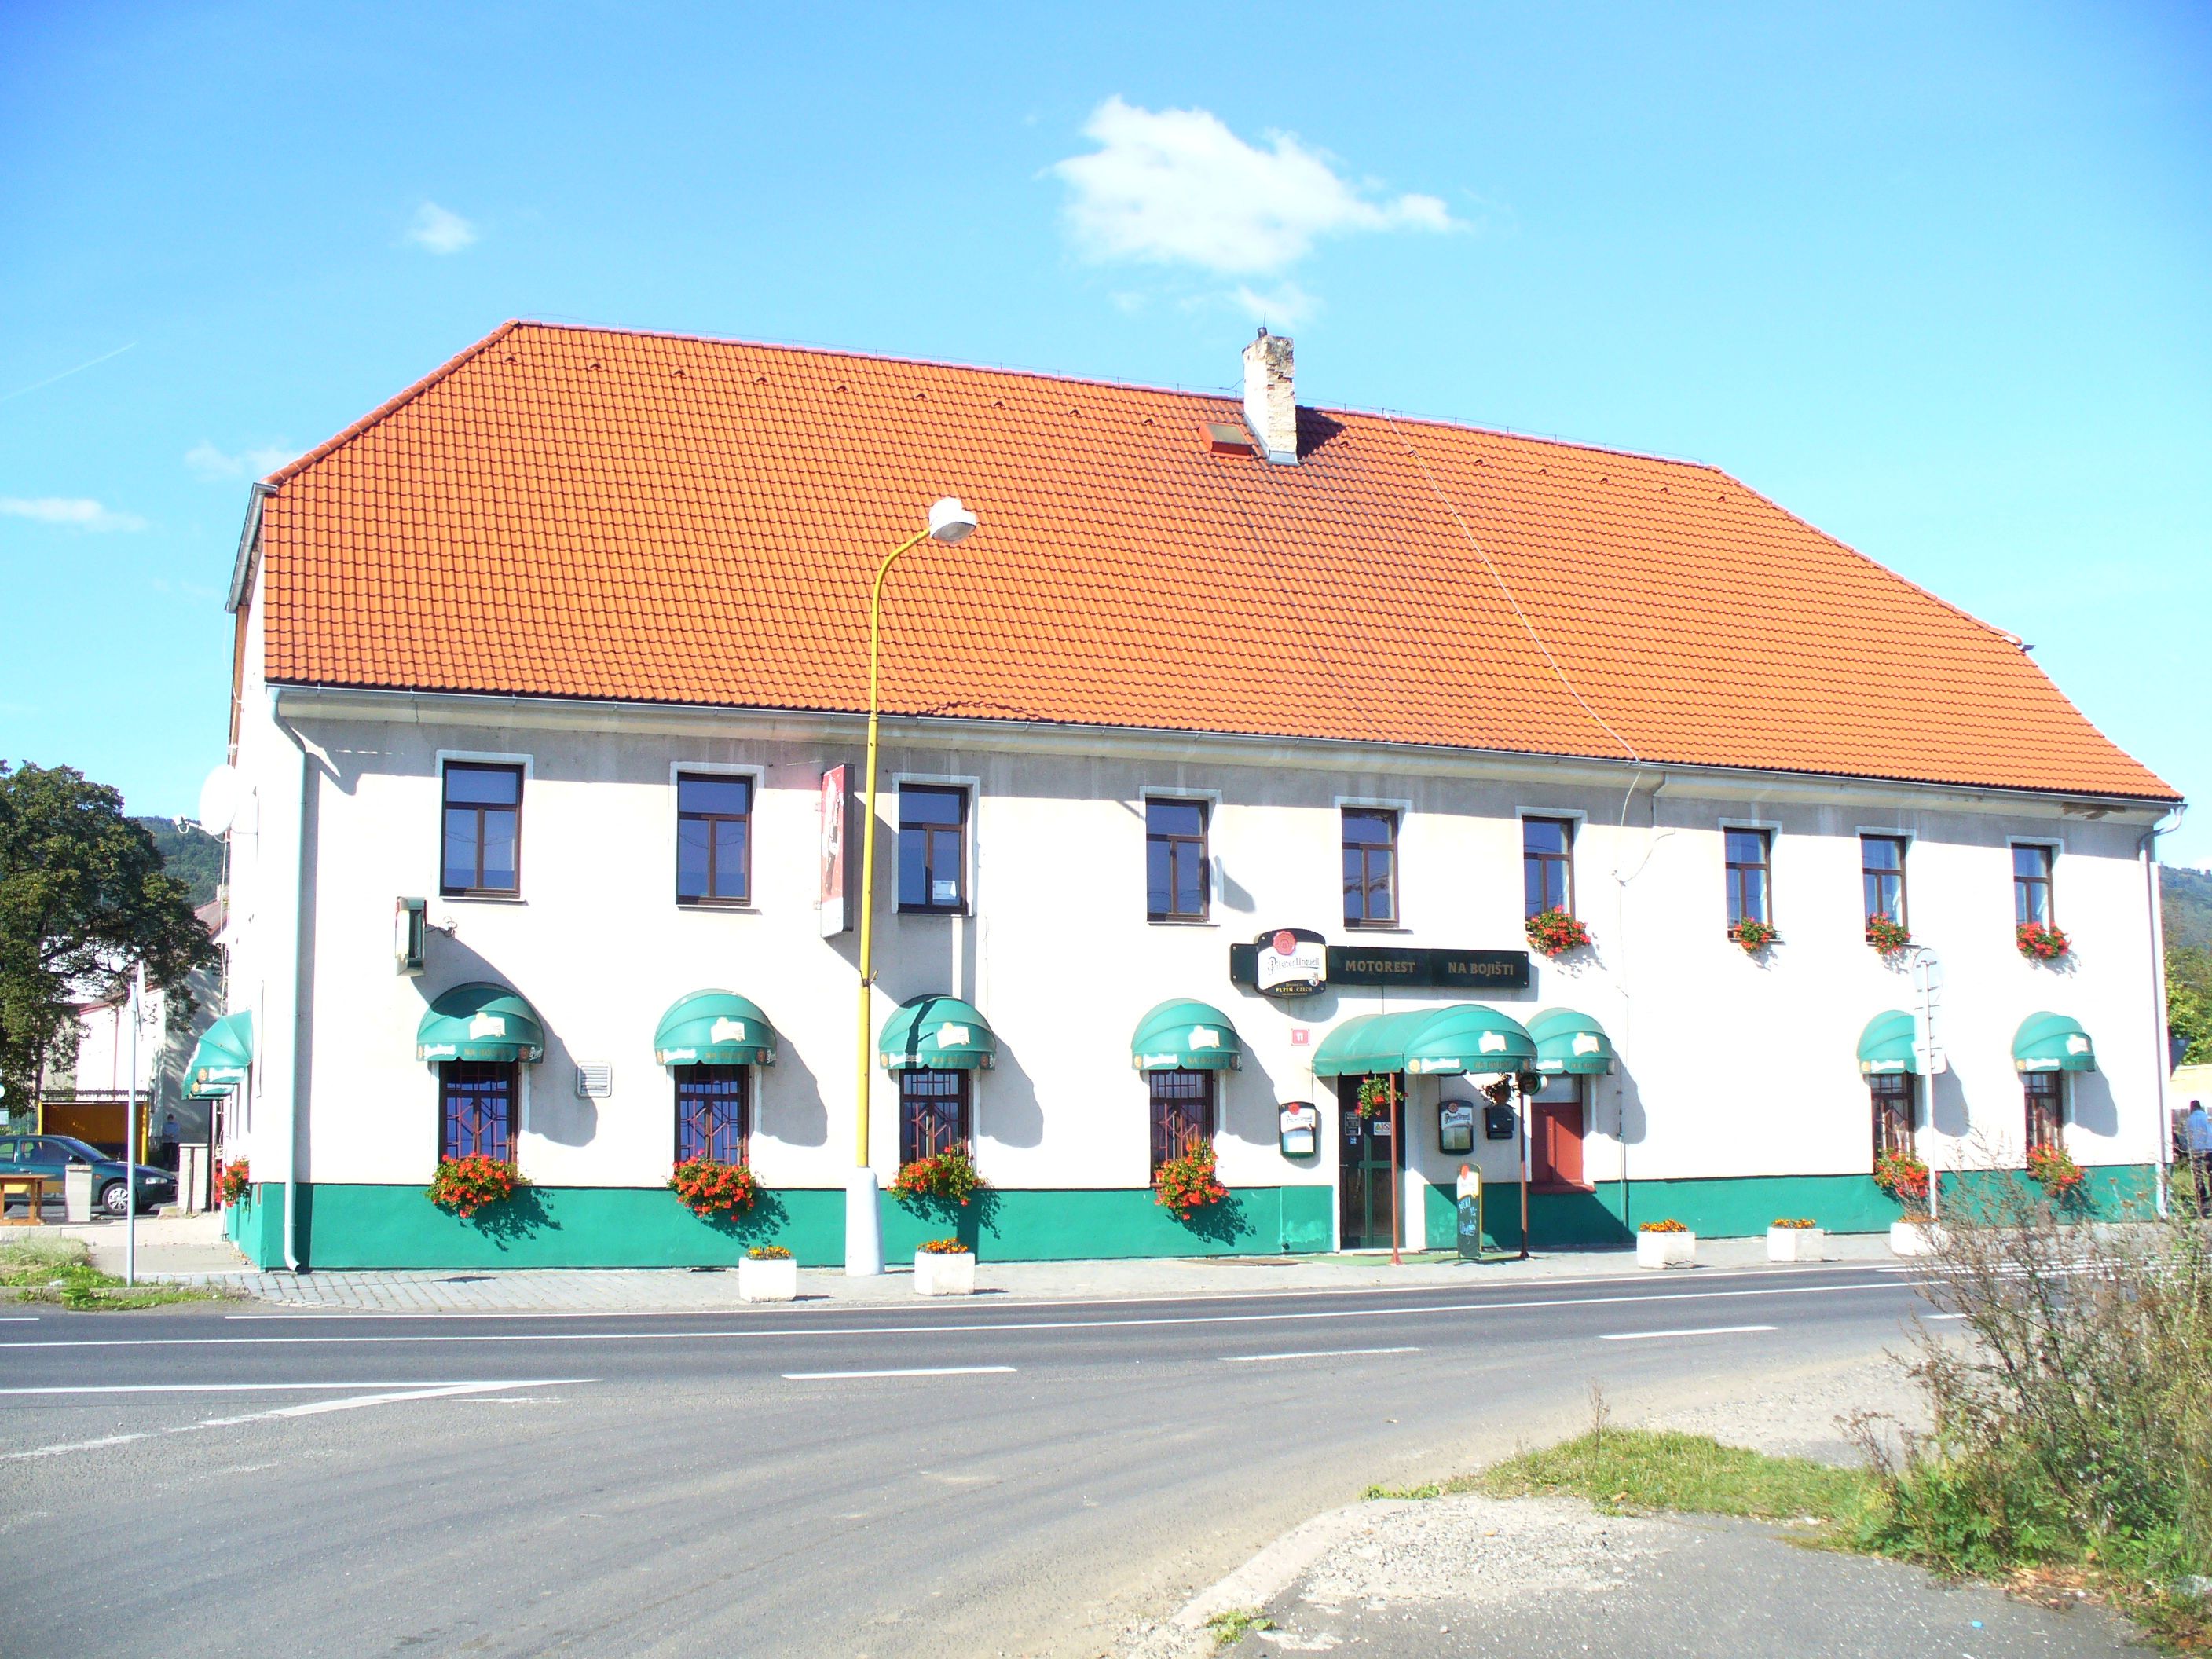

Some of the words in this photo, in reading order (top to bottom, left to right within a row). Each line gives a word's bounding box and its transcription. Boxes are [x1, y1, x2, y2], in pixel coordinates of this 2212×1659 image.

[1345, 960, 1415, 974] MOTOREST
[1448, 962, 1467, 974] NA
[1470, 961, 1514, 976] BOJIŠTI
